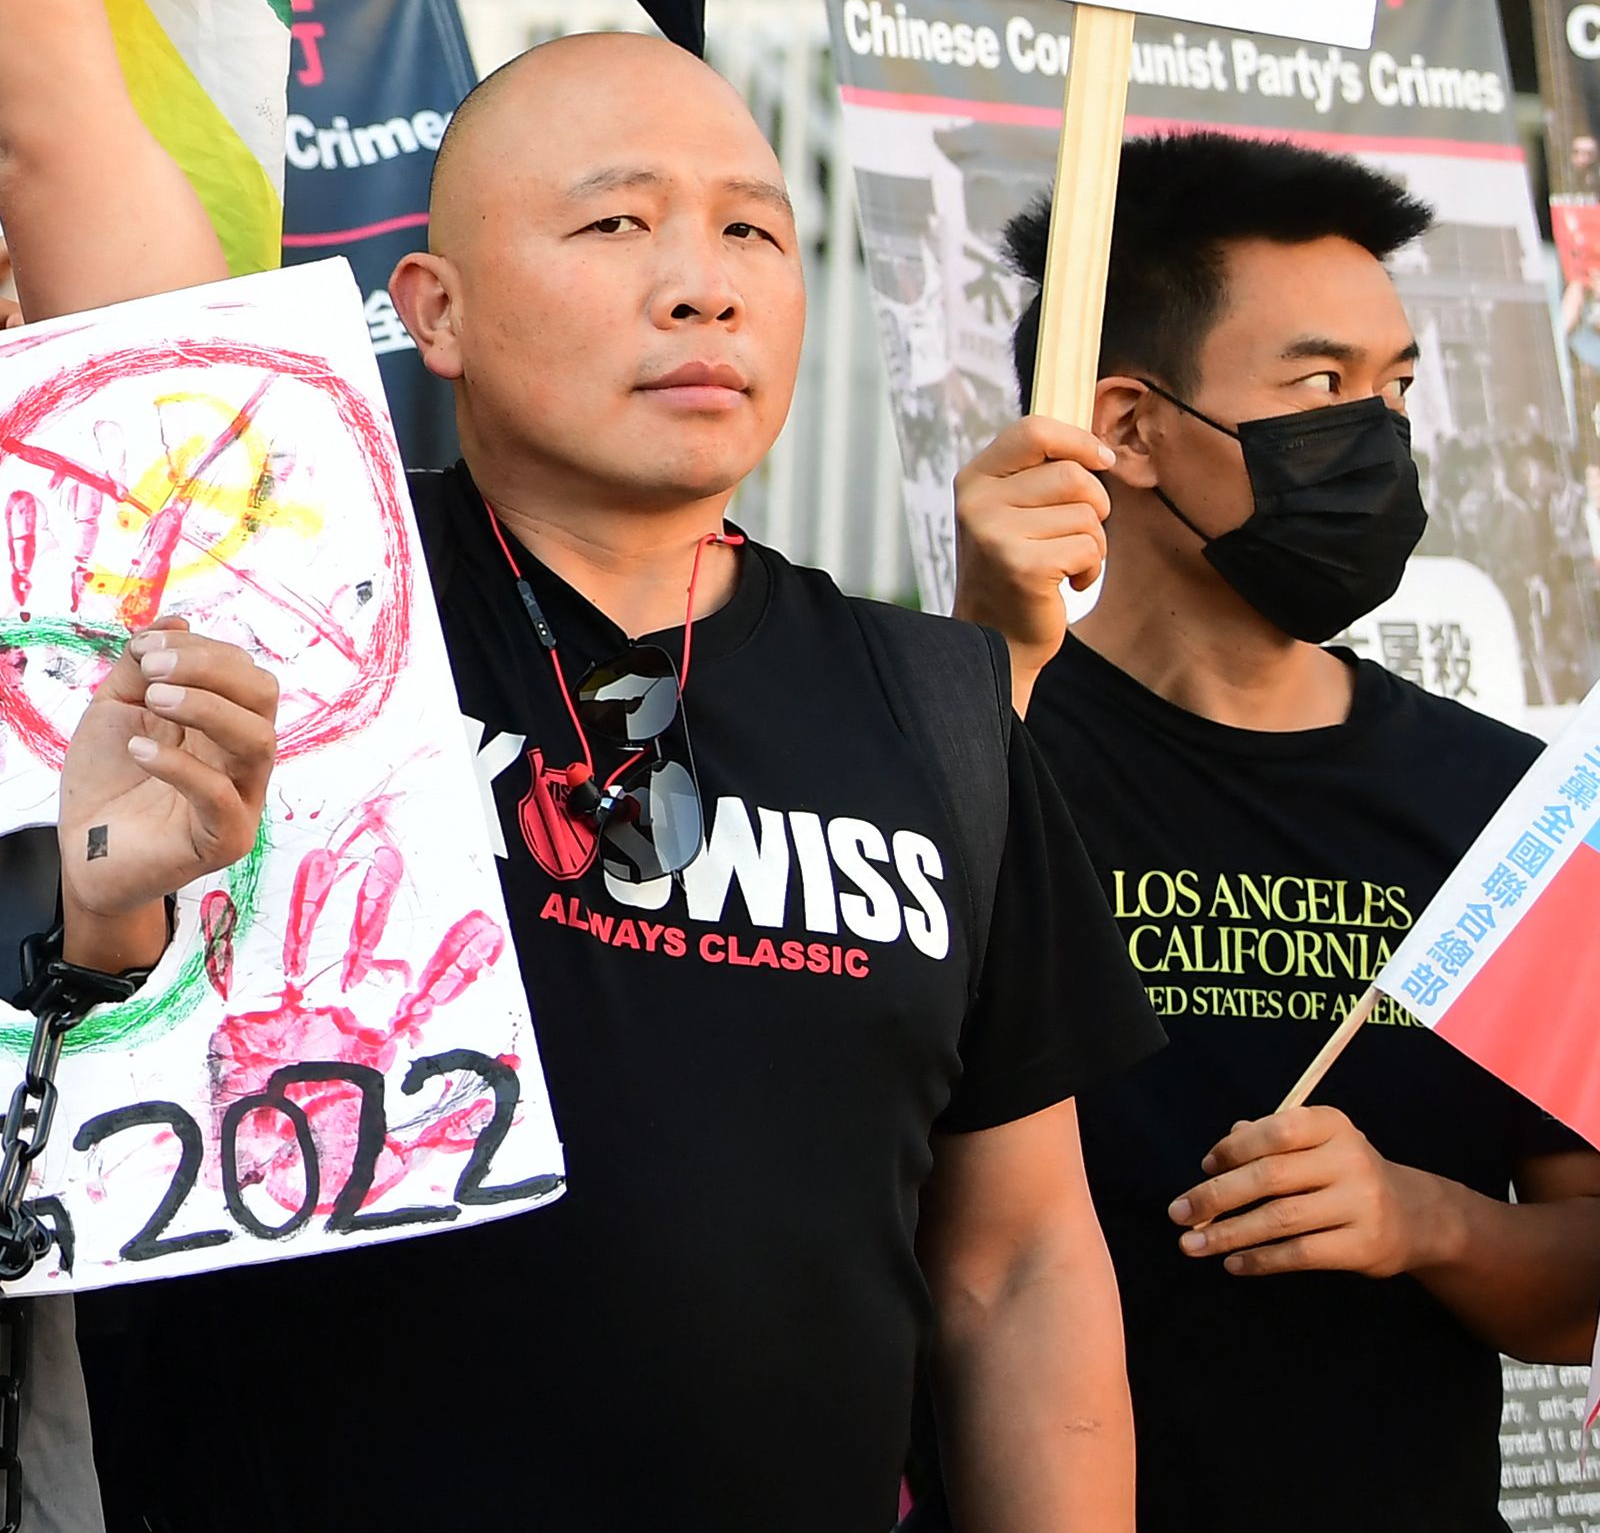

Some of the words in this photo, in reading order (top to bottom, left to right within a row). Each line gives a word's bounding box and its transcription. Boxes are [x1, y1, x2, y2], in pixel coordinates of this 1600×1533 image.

[1231, 37, 1364, 115] Party's
[1367, 51, 1506, 115] Crimes
[284, 108, 453, 170] Crime
[1112, 869, 1202, 918] LOS
[1207, 872, 1413, 931] ANGELES
[1399, 743, 1600, 1007] 黨全國聯合總部
[539, 892, 688, 958] ALWAYS
[699, 933, 870, 980] CLASSIC
[1192, 986, 1283, 1021] STATES
[1287, 991, 1327, 1020] OF
[73, 1048, 566, 1264] 2022
